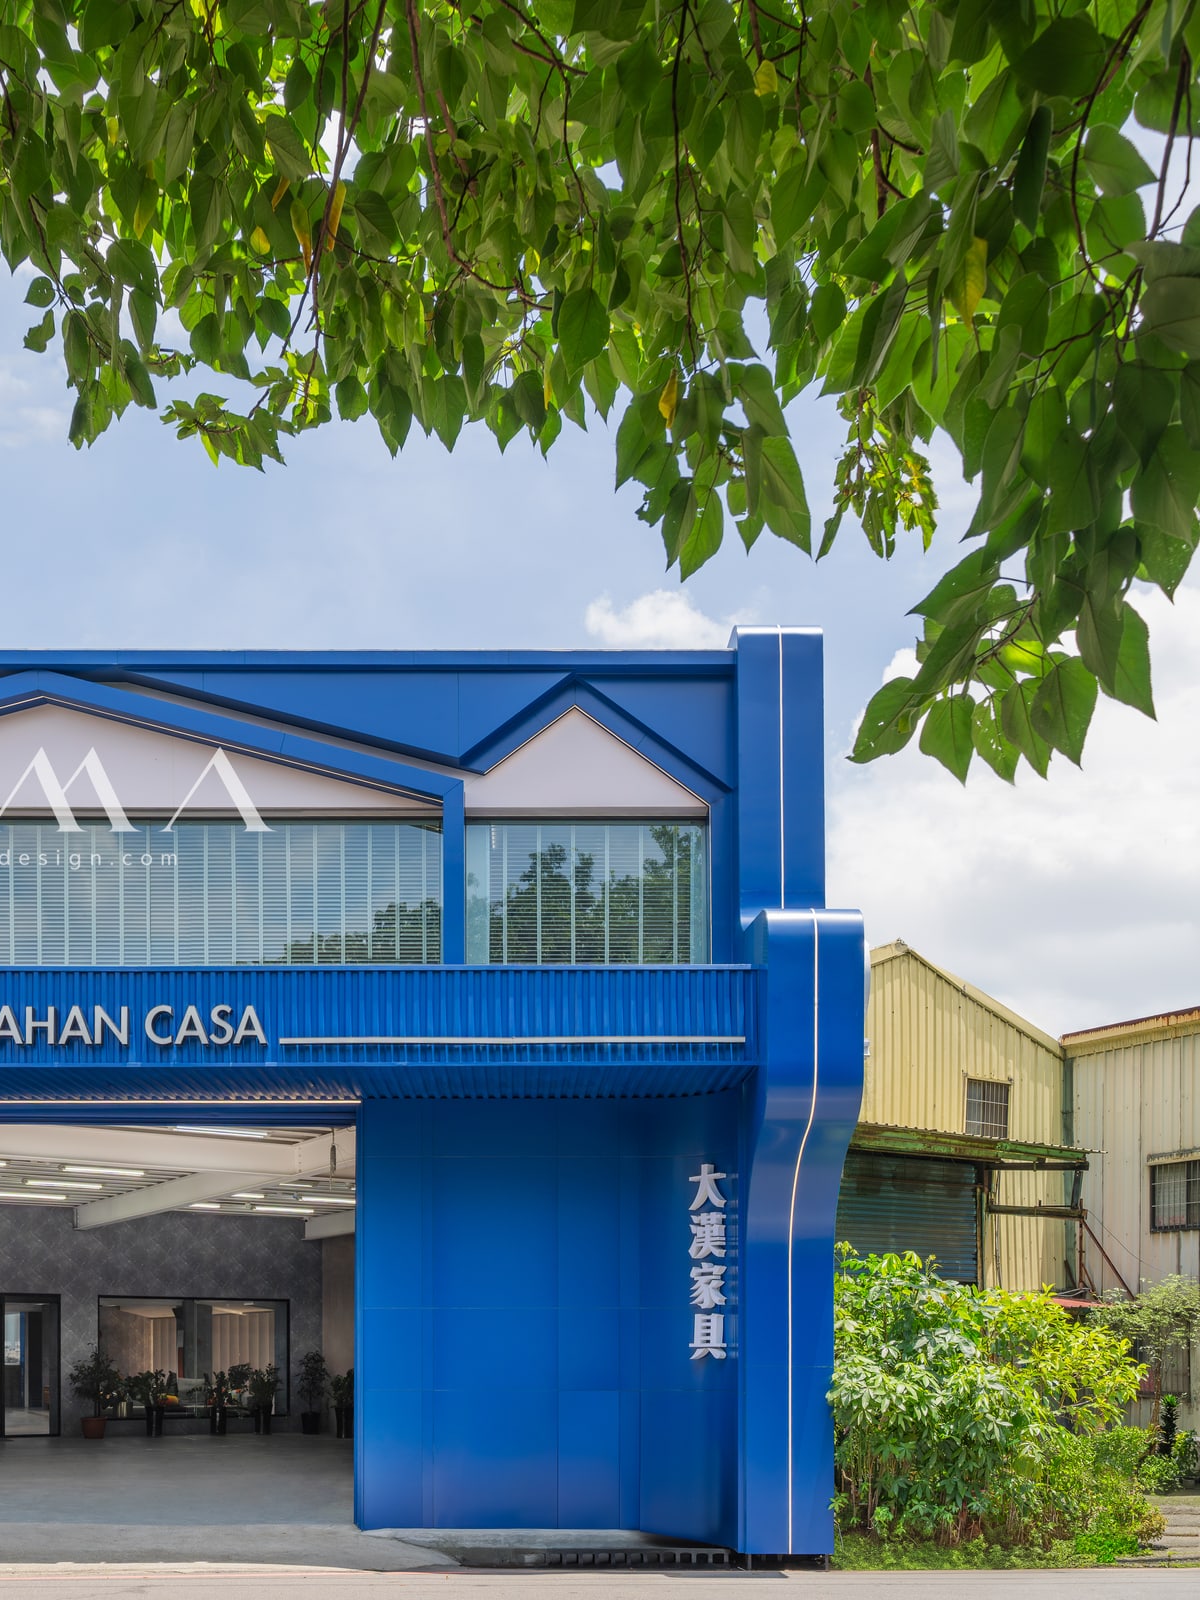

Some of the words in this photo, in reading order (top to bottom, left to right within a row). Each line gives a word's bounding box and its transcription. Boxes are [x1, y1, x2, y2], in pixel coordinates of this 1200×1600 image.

[144, 1004, 269, 1046] CASA
[688, 1163, 728, 1360] 大漢家具
